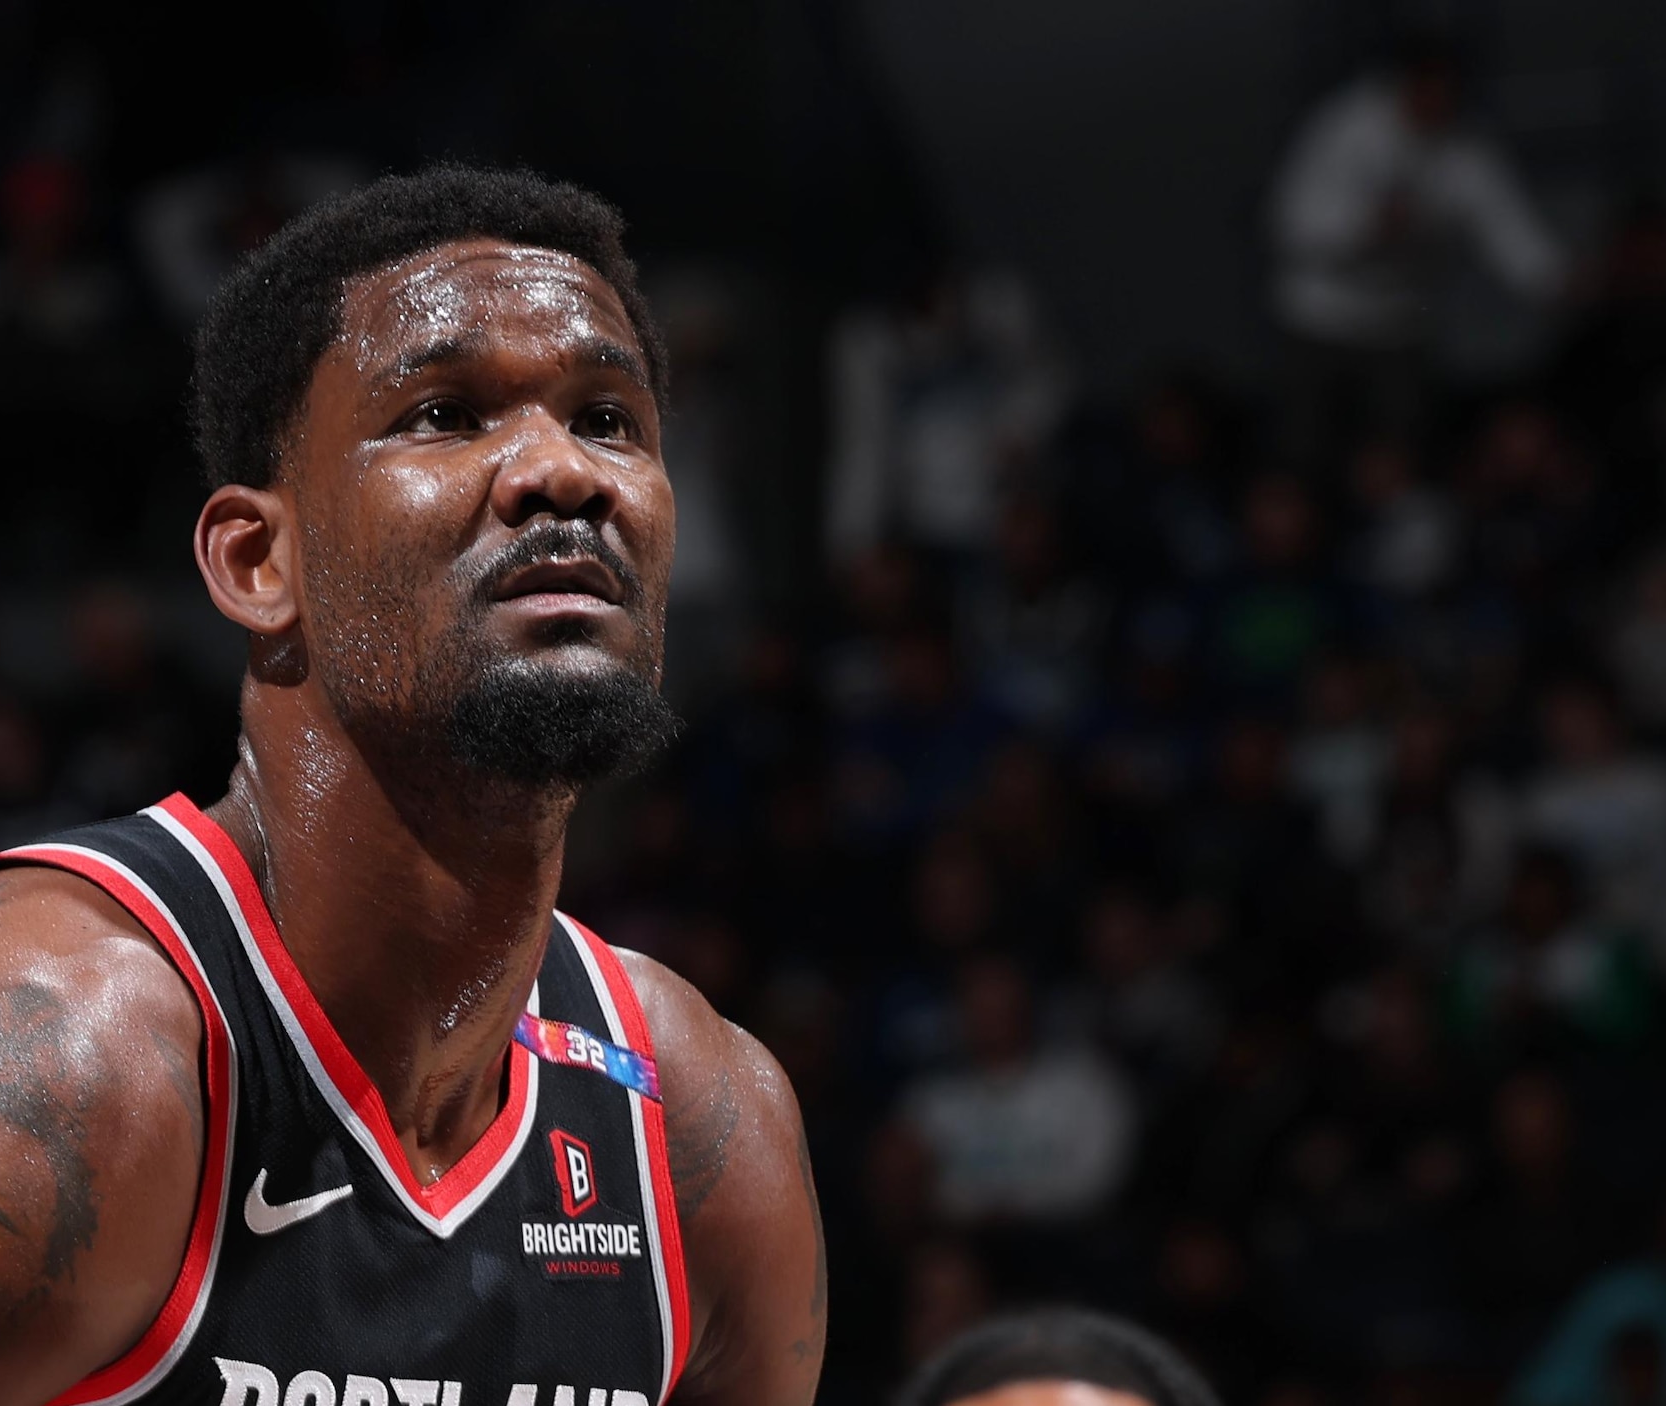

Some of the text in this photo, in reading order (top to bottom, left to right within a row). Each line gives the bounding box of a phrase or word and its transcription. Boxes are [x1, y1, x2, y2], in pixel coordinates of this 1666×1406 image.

[565, 1029, 608, 1073] 32
[566, 1145, 589, 1200] B
[522, 1223, 641, 1256] BRIGHTSIDE
[545, 1261, 620, 1275] WINDOWS
